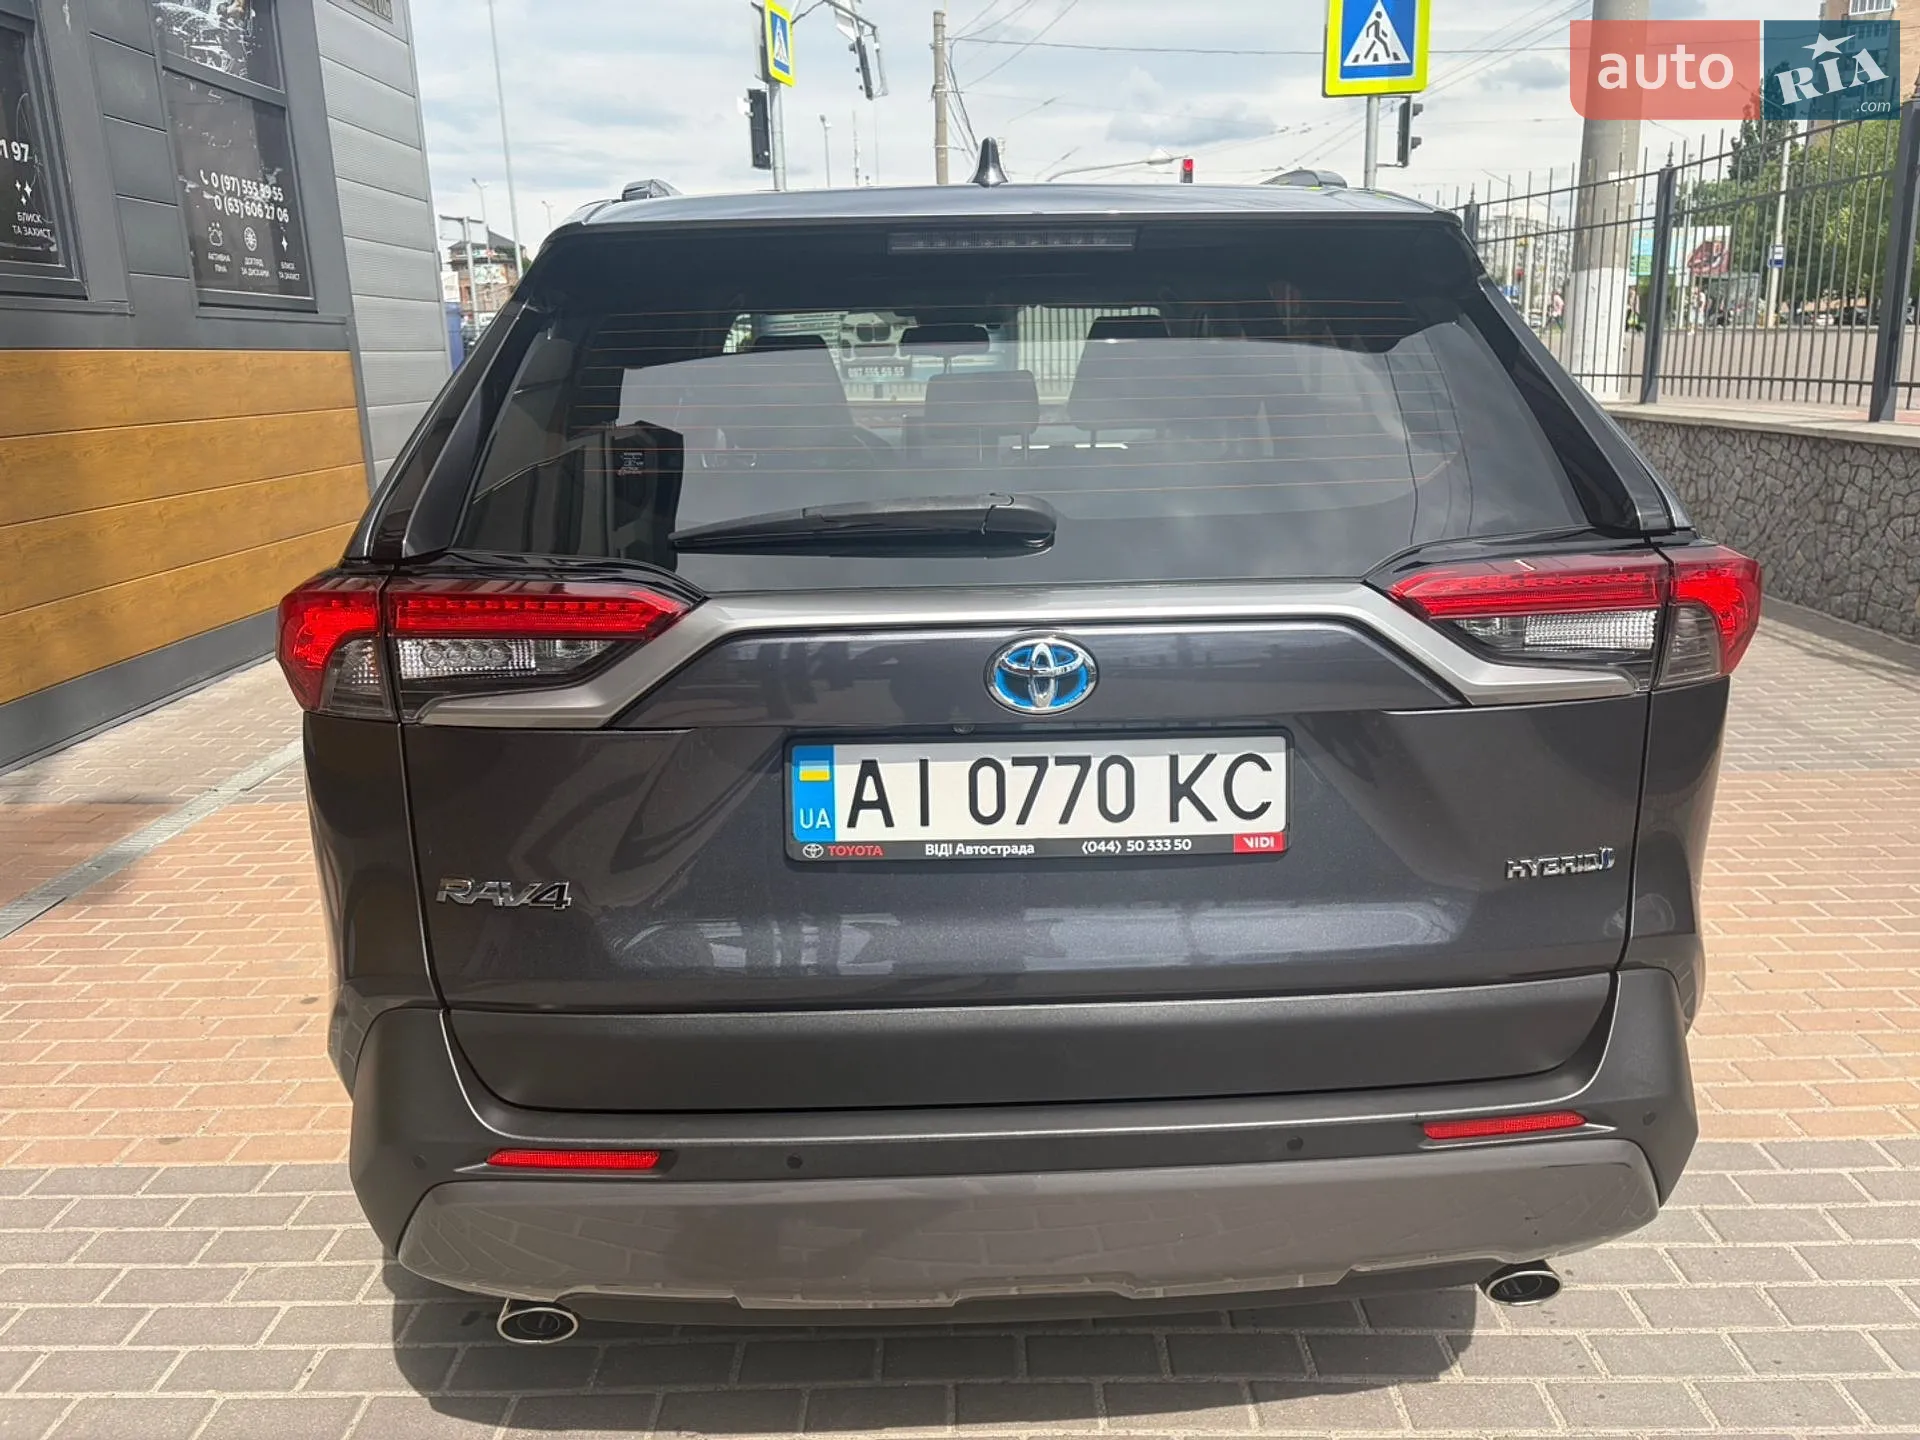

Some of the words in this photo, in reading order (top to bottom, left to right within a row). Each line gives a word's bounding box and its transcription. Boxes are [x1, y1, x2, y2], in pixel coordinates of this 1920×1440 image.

[11, 141, 29, 163] 97
[210, 172, 219, 188] 0
[220, 174, 240, 197] (97)
[214, 195, 222, 210] 0
[224, 196, 244, 219] (63)
[245, 201, 264, 218] 606
[277, 207, 289, 223] 06
[846, 757, 930, 829] AI
[968, 753, 1136, 826] 0770
[1168, 751, 1274, 823] KC
[800, 807, 831, 829] UA
[827, 844, 884, 858] TOYOTA
[925, 843, 953, 858] ВІДІ
[955, 842, 1035, 858] Автострада
[1081, 839, 1123, 855] (044)
[1241, 836, 1276, 850] VIDI
[1505, 853, 1601, 879] HYBRID
[436, 877, 573, 911] RAV4
